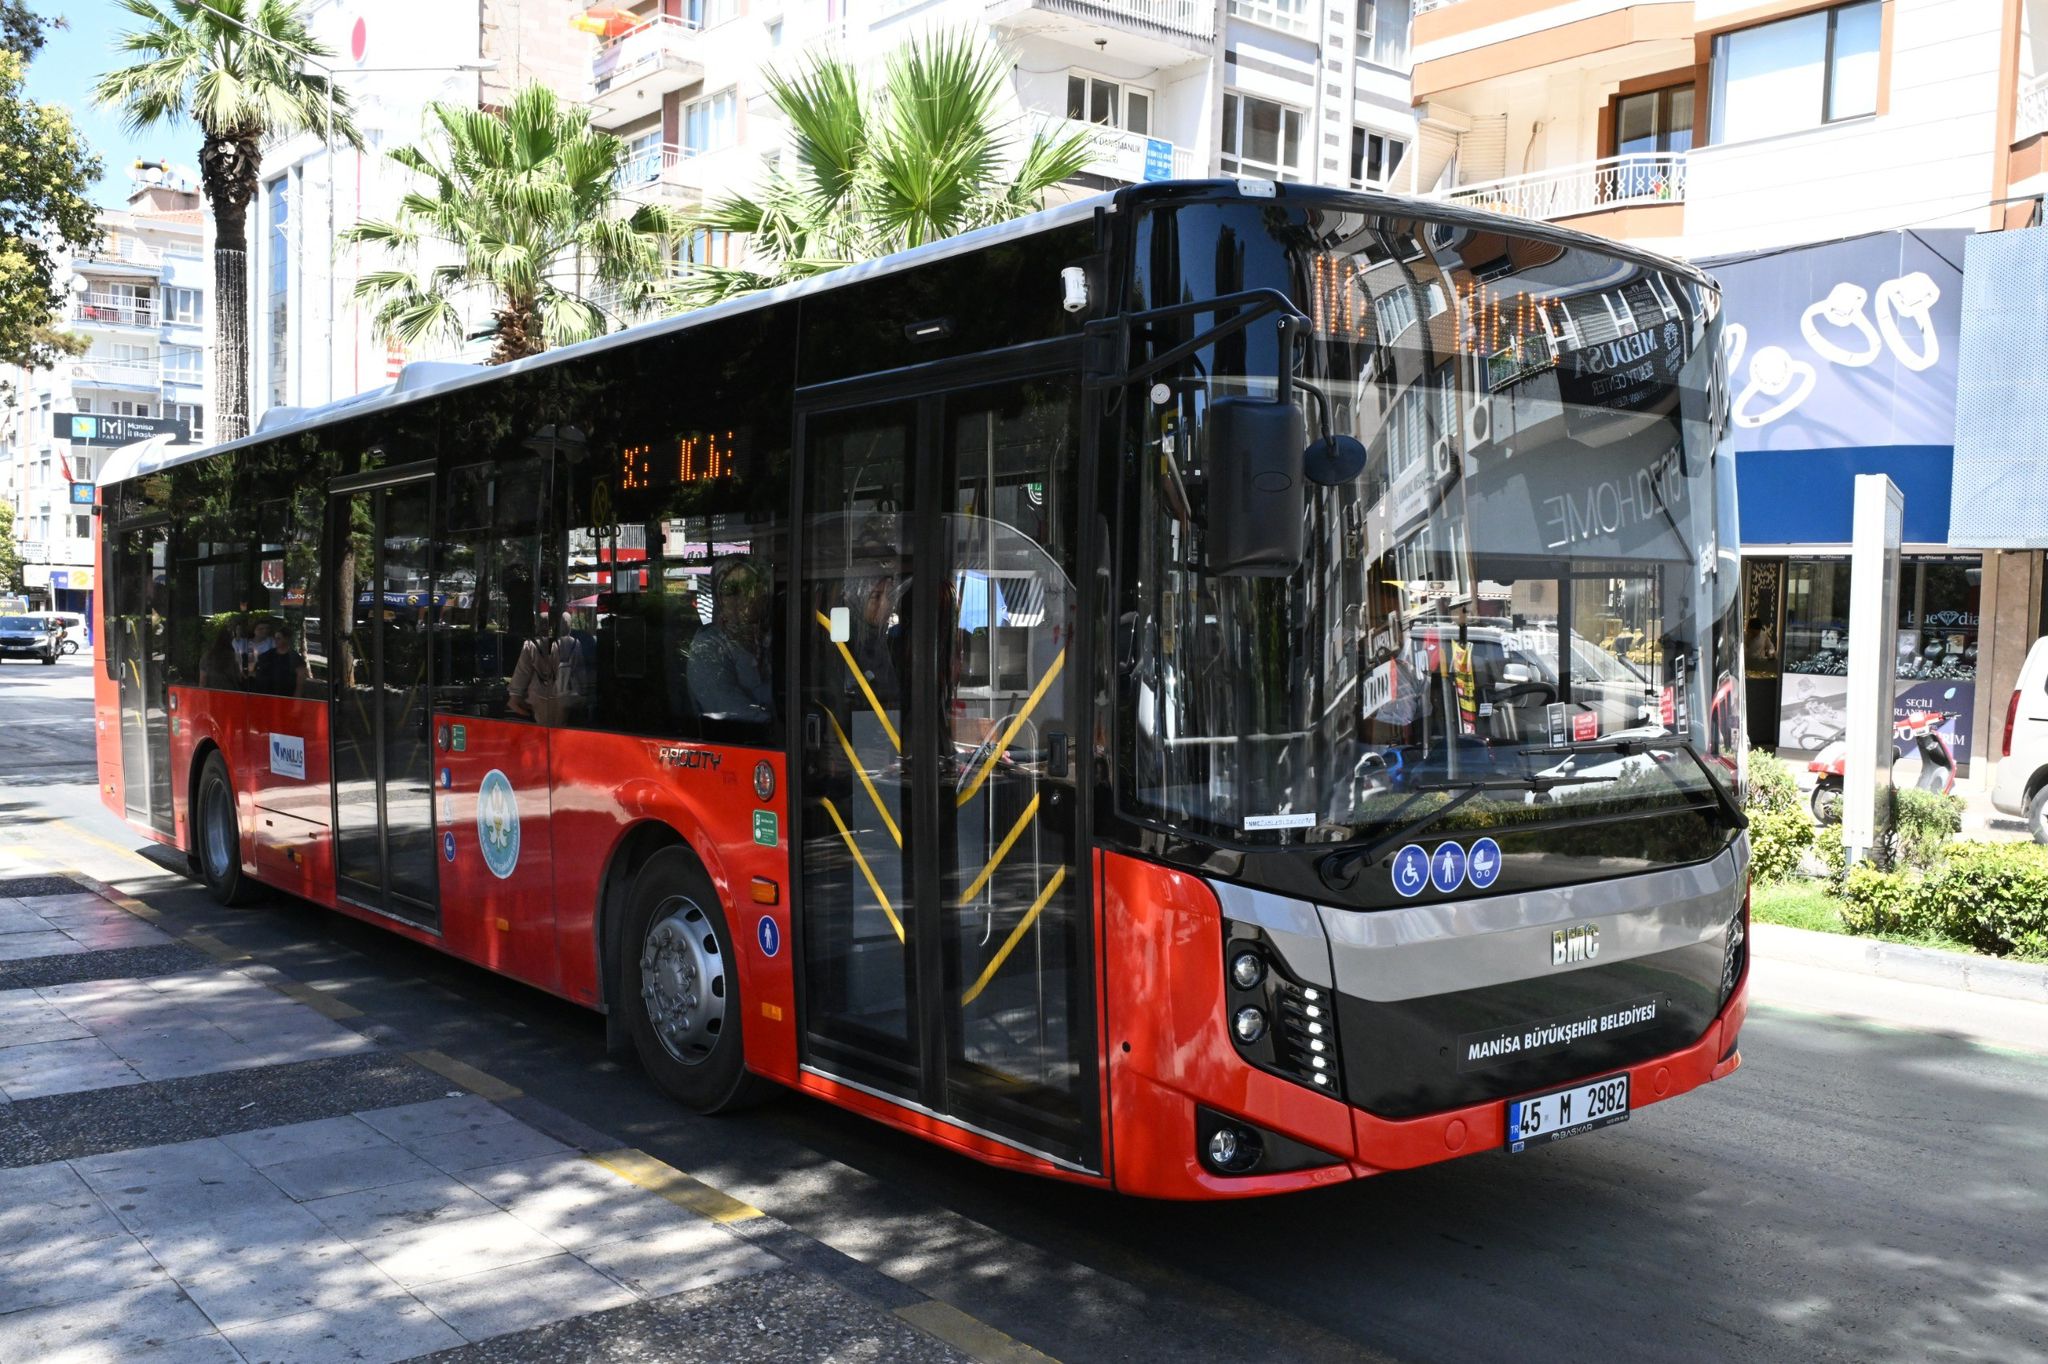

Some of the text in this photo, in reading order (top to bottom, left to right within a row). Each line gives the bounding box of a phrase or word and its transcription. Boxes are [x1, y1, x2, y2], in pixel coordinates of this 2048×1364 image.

[127, 422, 154, 431] Manisa
[1907, 610, 1937, 624] bue
[659, 746, 722, 771] PROCITY
[1552, 923, 1600, 966] BMC
[1468, 1000, 1656, 1061] MANİSA BÜYÜKŞEHİR BELEDİYESİ
[1520, 1080, 1625, 1135] 45 M 2982
[1510, 1124, 1520, 1134] TR
